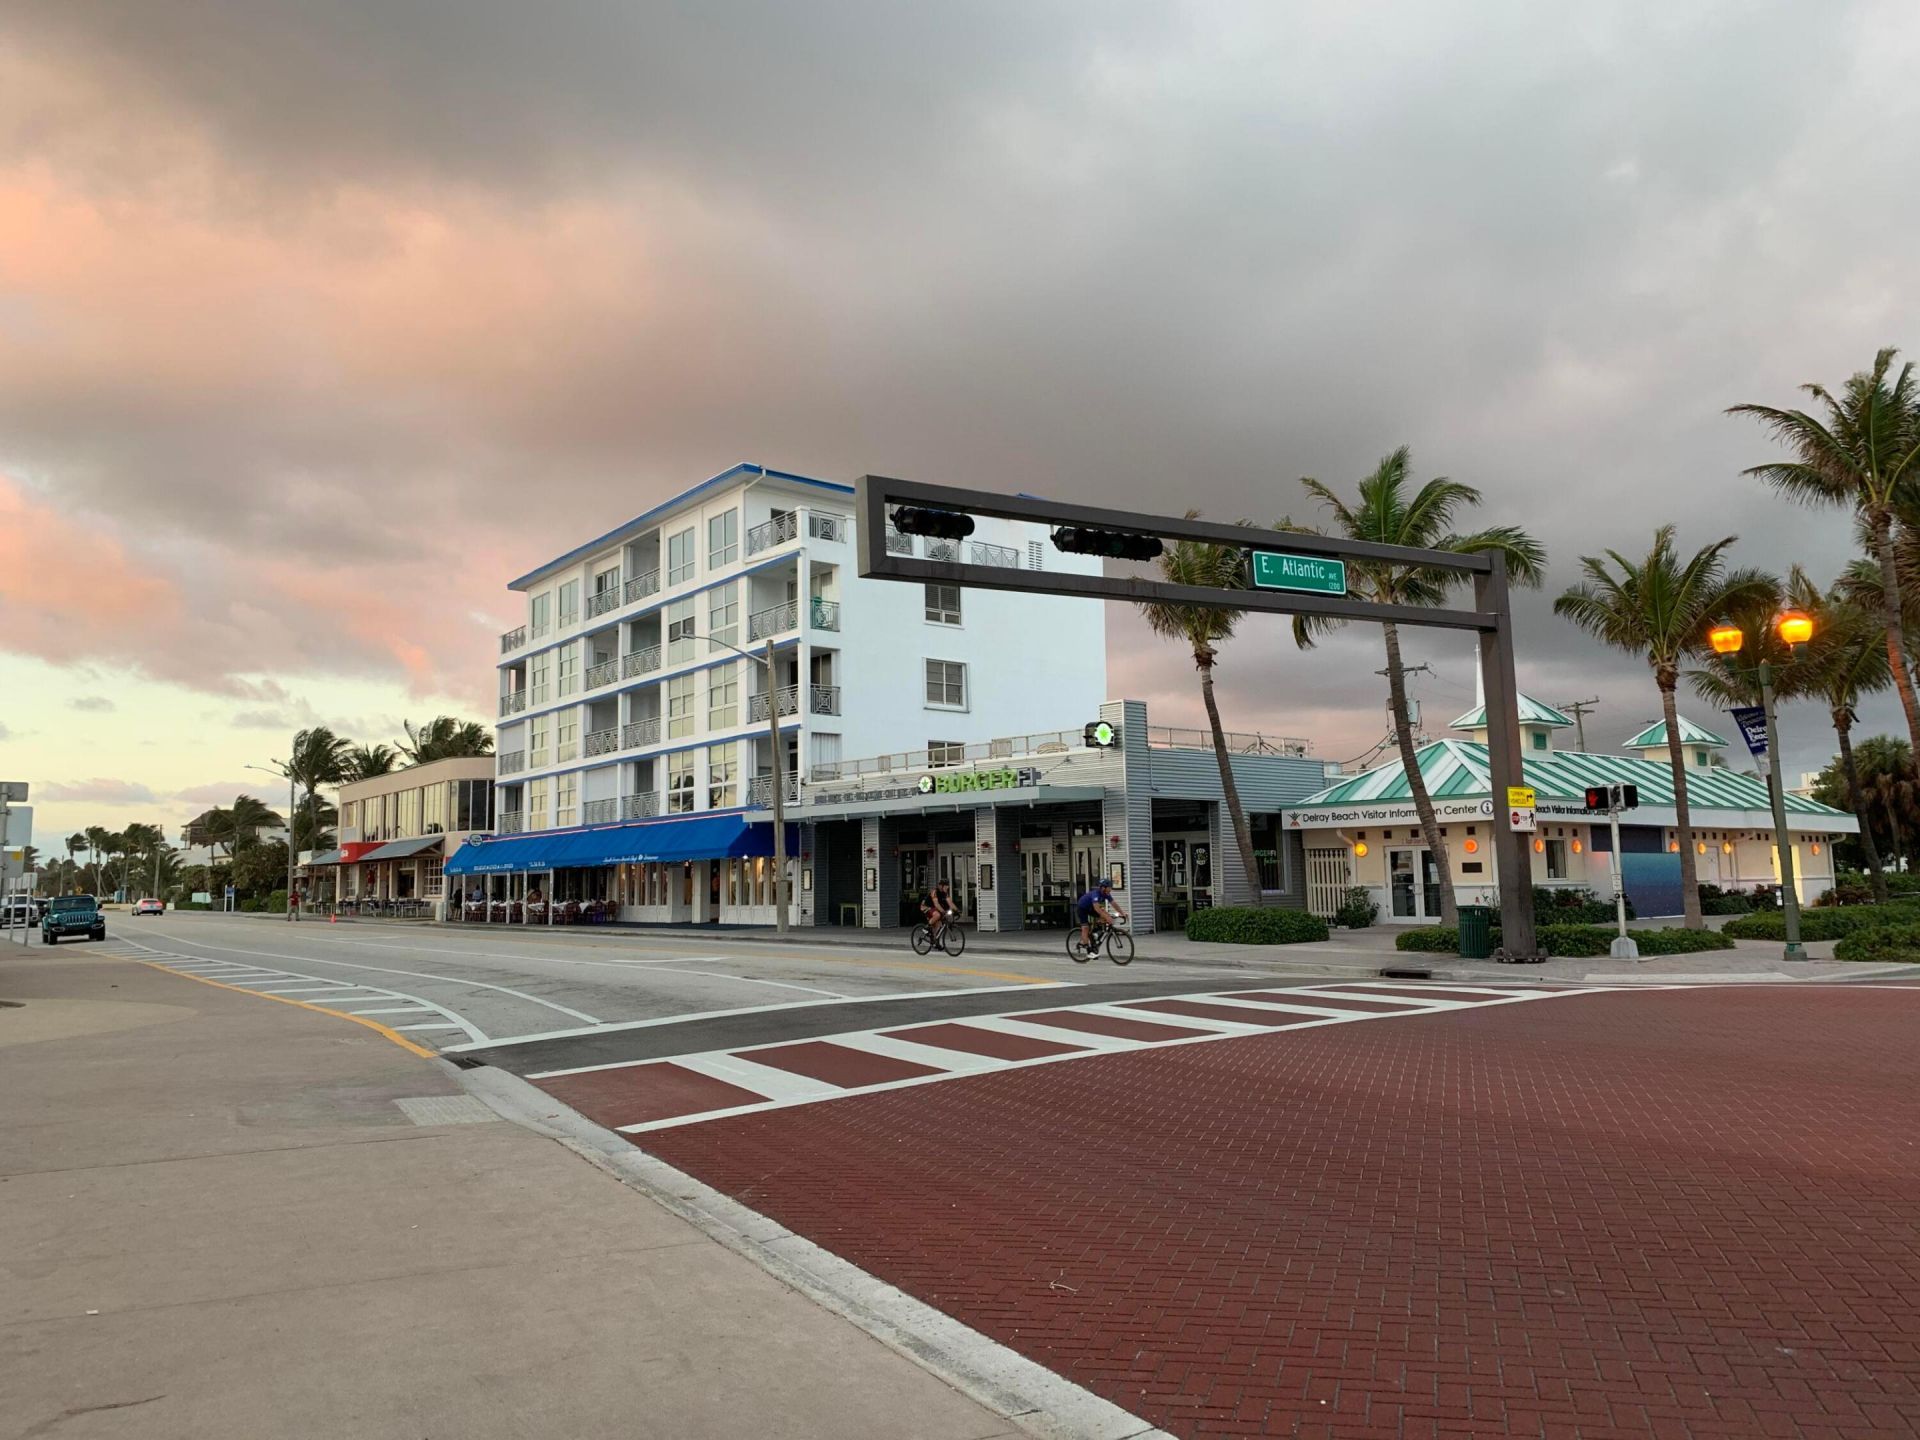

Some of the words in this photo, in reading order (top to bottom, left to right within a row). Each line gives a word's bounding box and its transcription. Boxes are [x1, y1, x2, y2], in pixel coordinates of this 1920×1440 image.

[1261, 556, 1274, 574] E.
[1282, 558, 1325, 580] Atlantic
[1328, 582, 1341, 590] 1200
[1745, 725, 1768, 735] Delra
[1748, 734, 1769, 743] Beac
[1303, 812, 1330, 822] Delray
[1331, 811, 1360, 821] Beach
[1361, 809, 1387, 820] Visitor
[1389, 807, 1442, 818] Informon
[1444, 804, 1478, 815] Center
